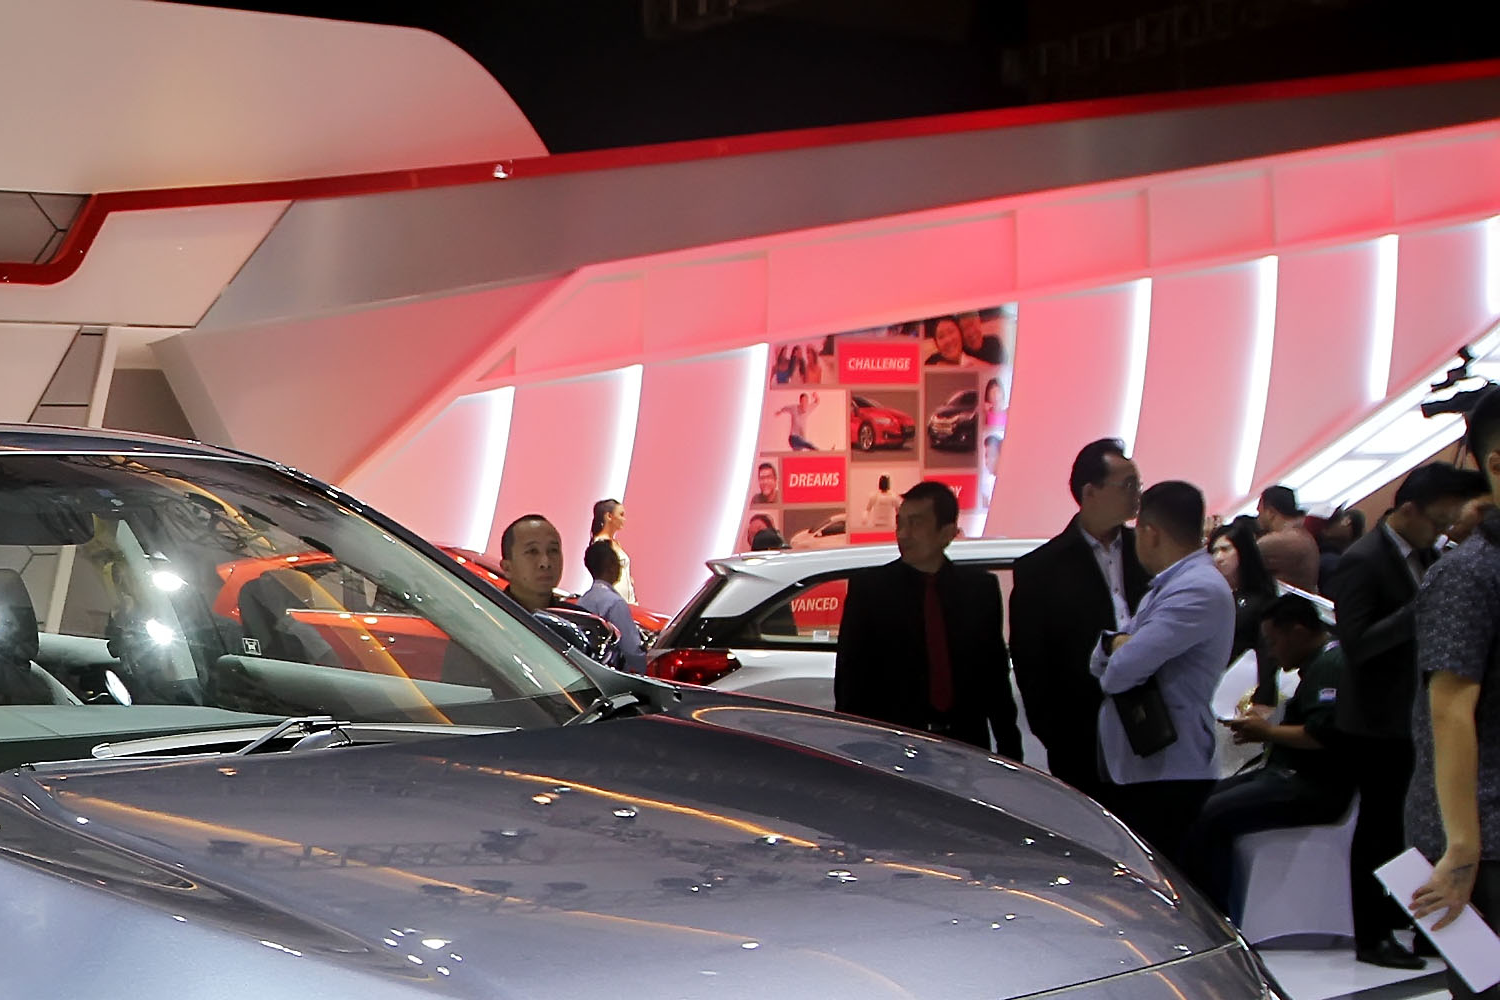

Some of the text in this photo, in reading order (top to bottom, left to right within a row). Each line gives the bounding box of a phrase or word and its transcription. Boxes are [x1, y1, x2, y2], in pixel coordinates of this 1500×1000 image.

[848, 357, 911, 371] CHALLENGE
[789, 472, 840, 487] DREAMS
[790, 597, 839, 613] VANCED
